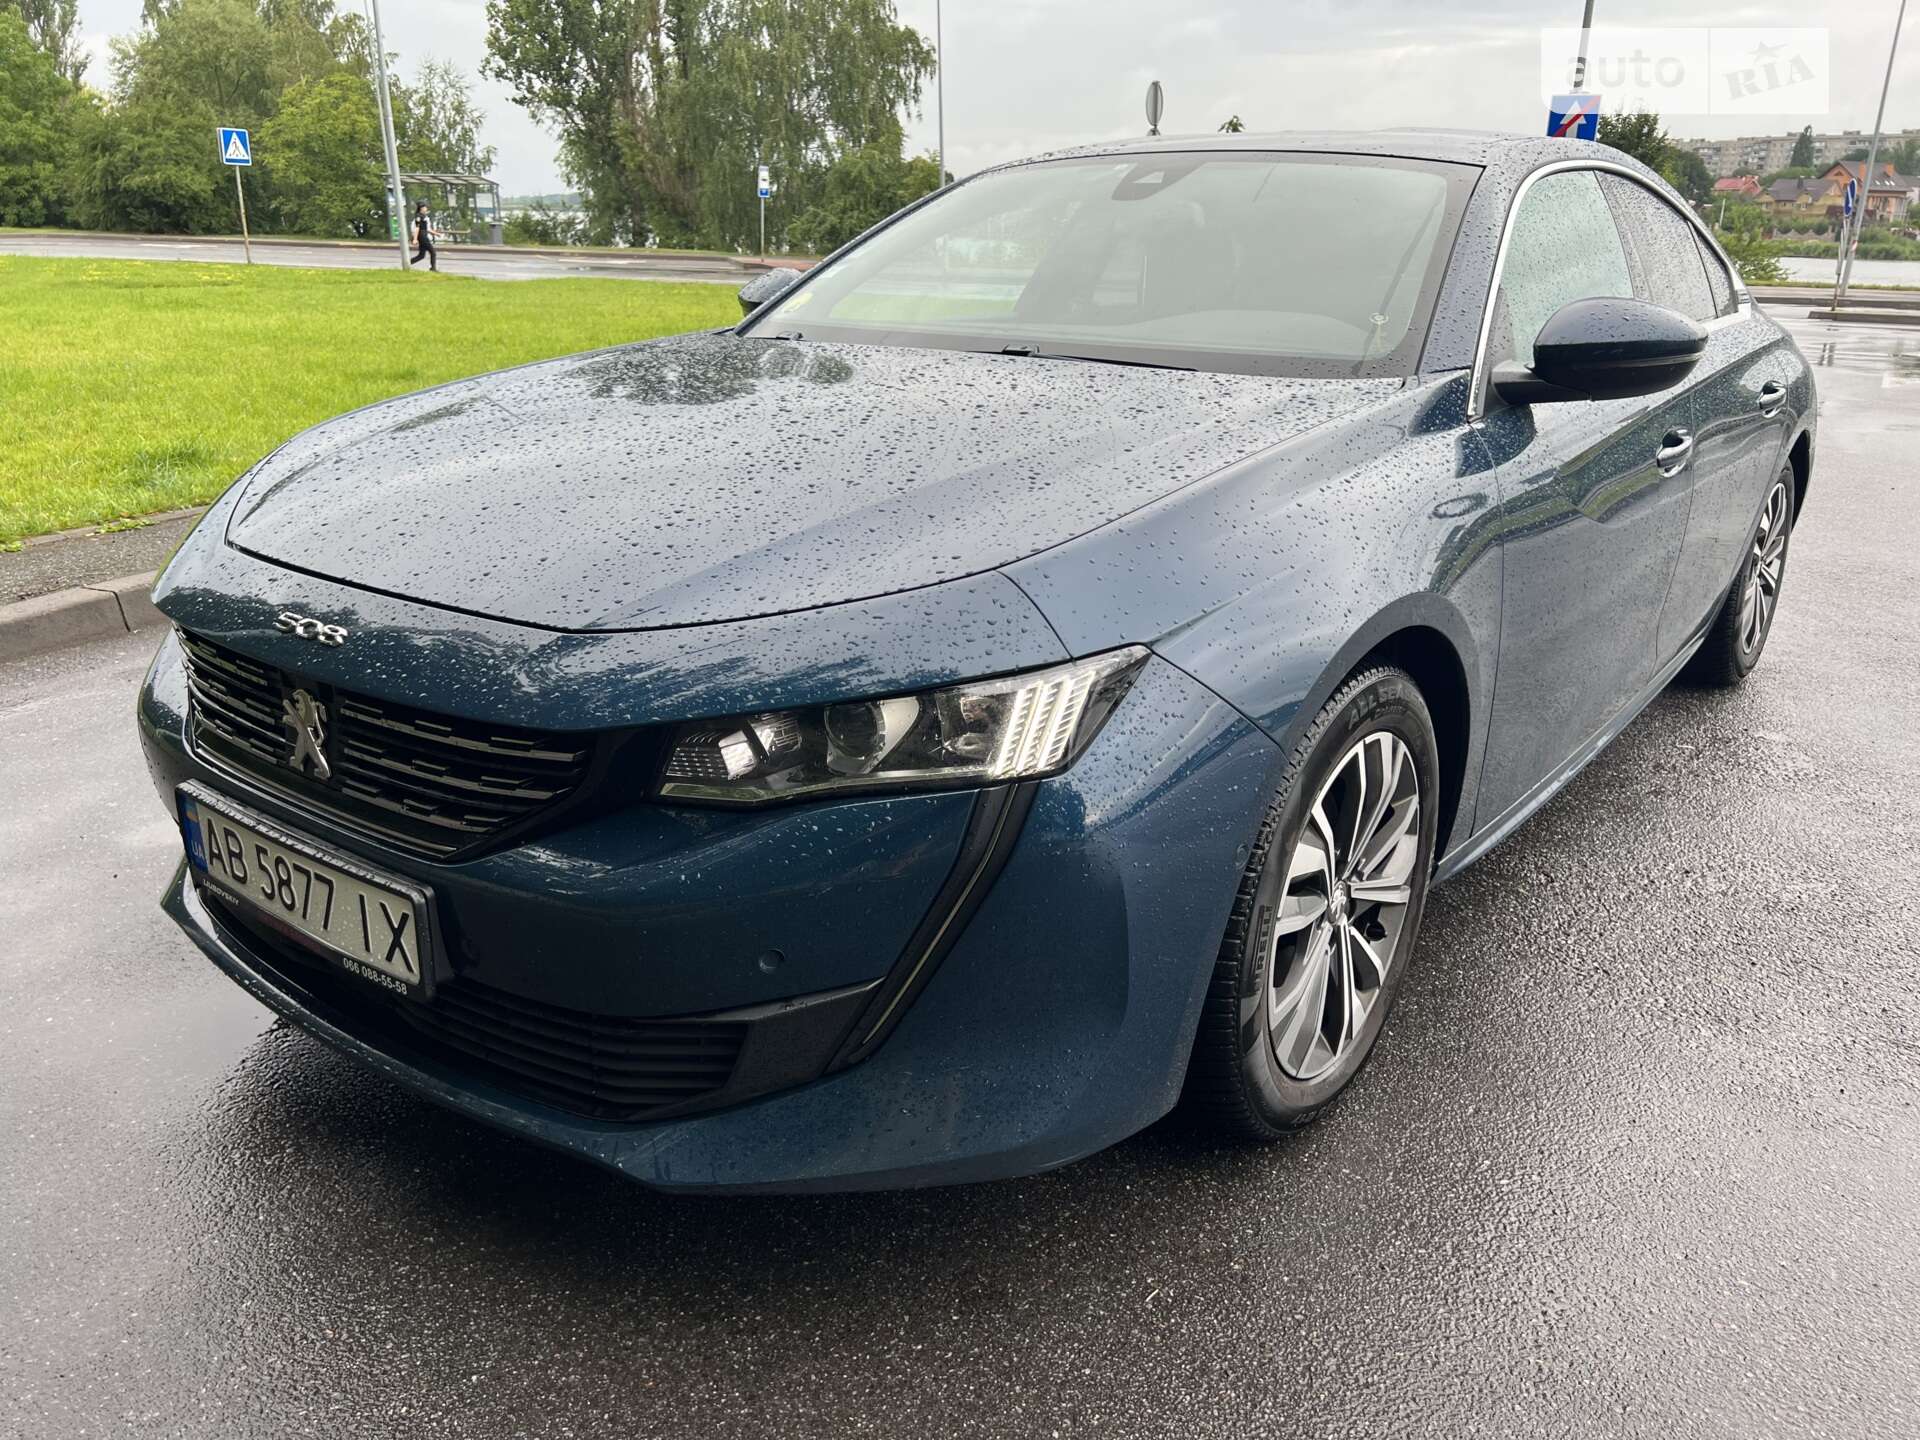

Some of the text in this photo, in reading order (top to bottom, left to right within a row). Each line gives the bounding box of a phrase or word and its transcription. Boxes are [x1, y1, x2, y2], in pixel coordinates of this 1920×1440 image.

[272, 611, 349, 647] 508
[190, 839, 206, 861] UA
[206, 818, 249, 885] AB
[254, 845, 336, 931] 5877
[358, 893, 416, 974] IX
[343, 957, 408, 995] 066 088-55-58
